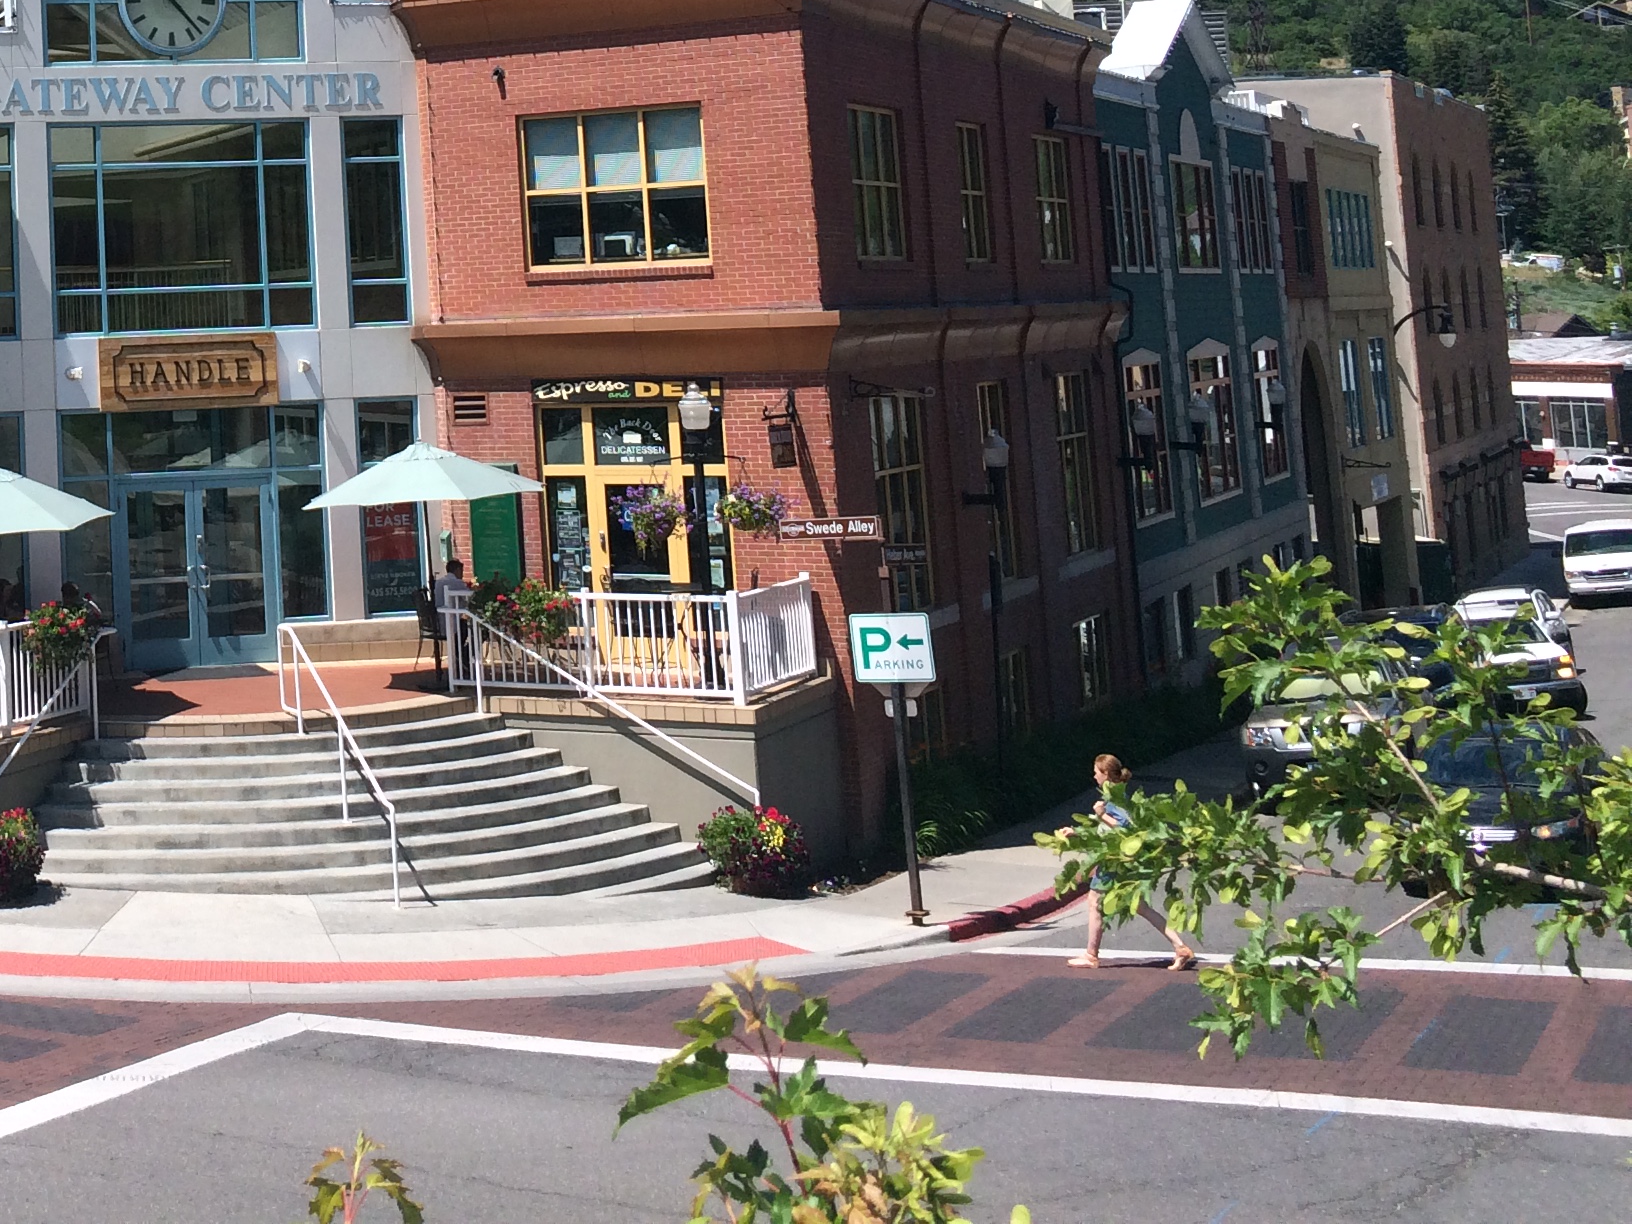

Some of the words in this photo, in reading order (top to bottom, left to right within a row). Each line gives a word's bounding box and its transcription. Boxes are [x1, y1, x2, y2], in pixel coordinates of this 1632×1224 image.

[200, 73, 384, 113] CENTER
[129, 358, 250, 385] HANDLE
[534, 380, 630, 401] Espresso
[608, 391, 631, 399] and
[602, 424, 619, 440] The
[619, 418, 641, 428] Back
[642, 421, 663, 441] Door
[601, 445, 666, 455] DELICATESSEN
[366, 514, 410, 528] LEASE
[805, 521, 843, 535] Swede
[848, 519, 875, 535] Alley
[859, 627, 924, 670] PARKING
